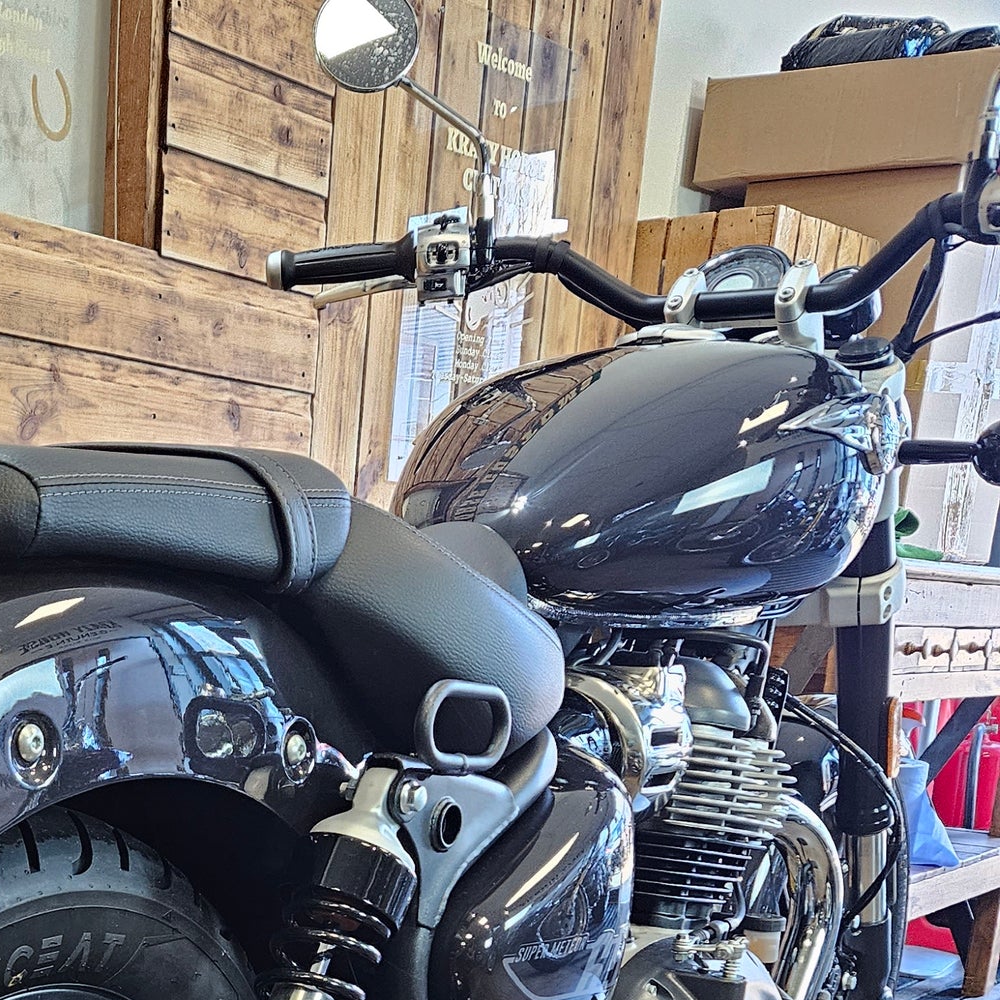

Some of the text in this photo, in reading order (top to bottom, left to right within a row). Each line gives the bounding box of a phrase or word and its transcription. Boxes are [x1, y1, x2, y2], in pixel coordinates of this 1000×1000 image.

[477, 40, 533, 83] Welcome
[446, 126, 500, 165] KRAY
[3, 931, 127, 988] CEAT
[515, 936, 588, 963] SUPER METEOR
